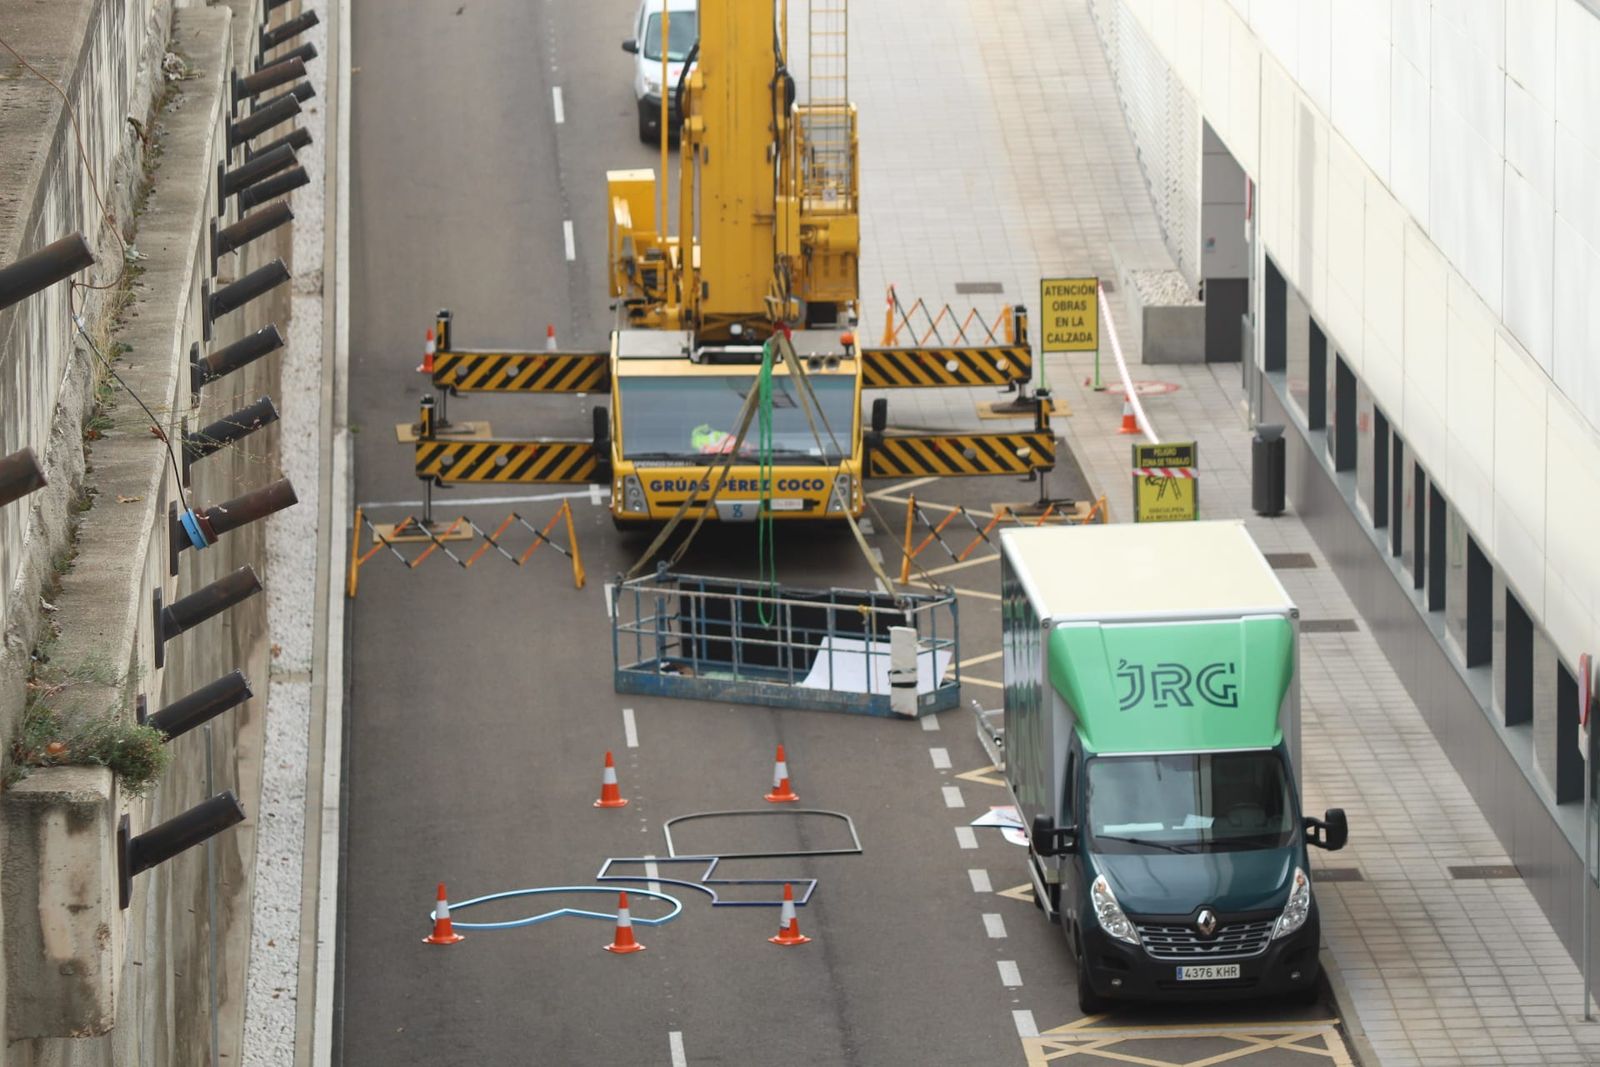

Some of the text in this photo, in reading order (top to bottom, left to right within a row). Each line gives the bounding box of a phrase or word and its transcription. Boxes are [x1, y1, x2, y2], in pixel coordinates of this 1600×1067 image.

[1044, 283, 1096, 296] ATENCIÓN
[1052, 300, 1087, 311] OBRAS
[1055, 316, 1084, 327] EN LA
[1046, 332, 1093, 343] CALZADA
[650, 477, 710, 492] GRÚAS
[777, 479, 825, 492] COCO
[1184, 966, 1238, 978] 4376 KHR
